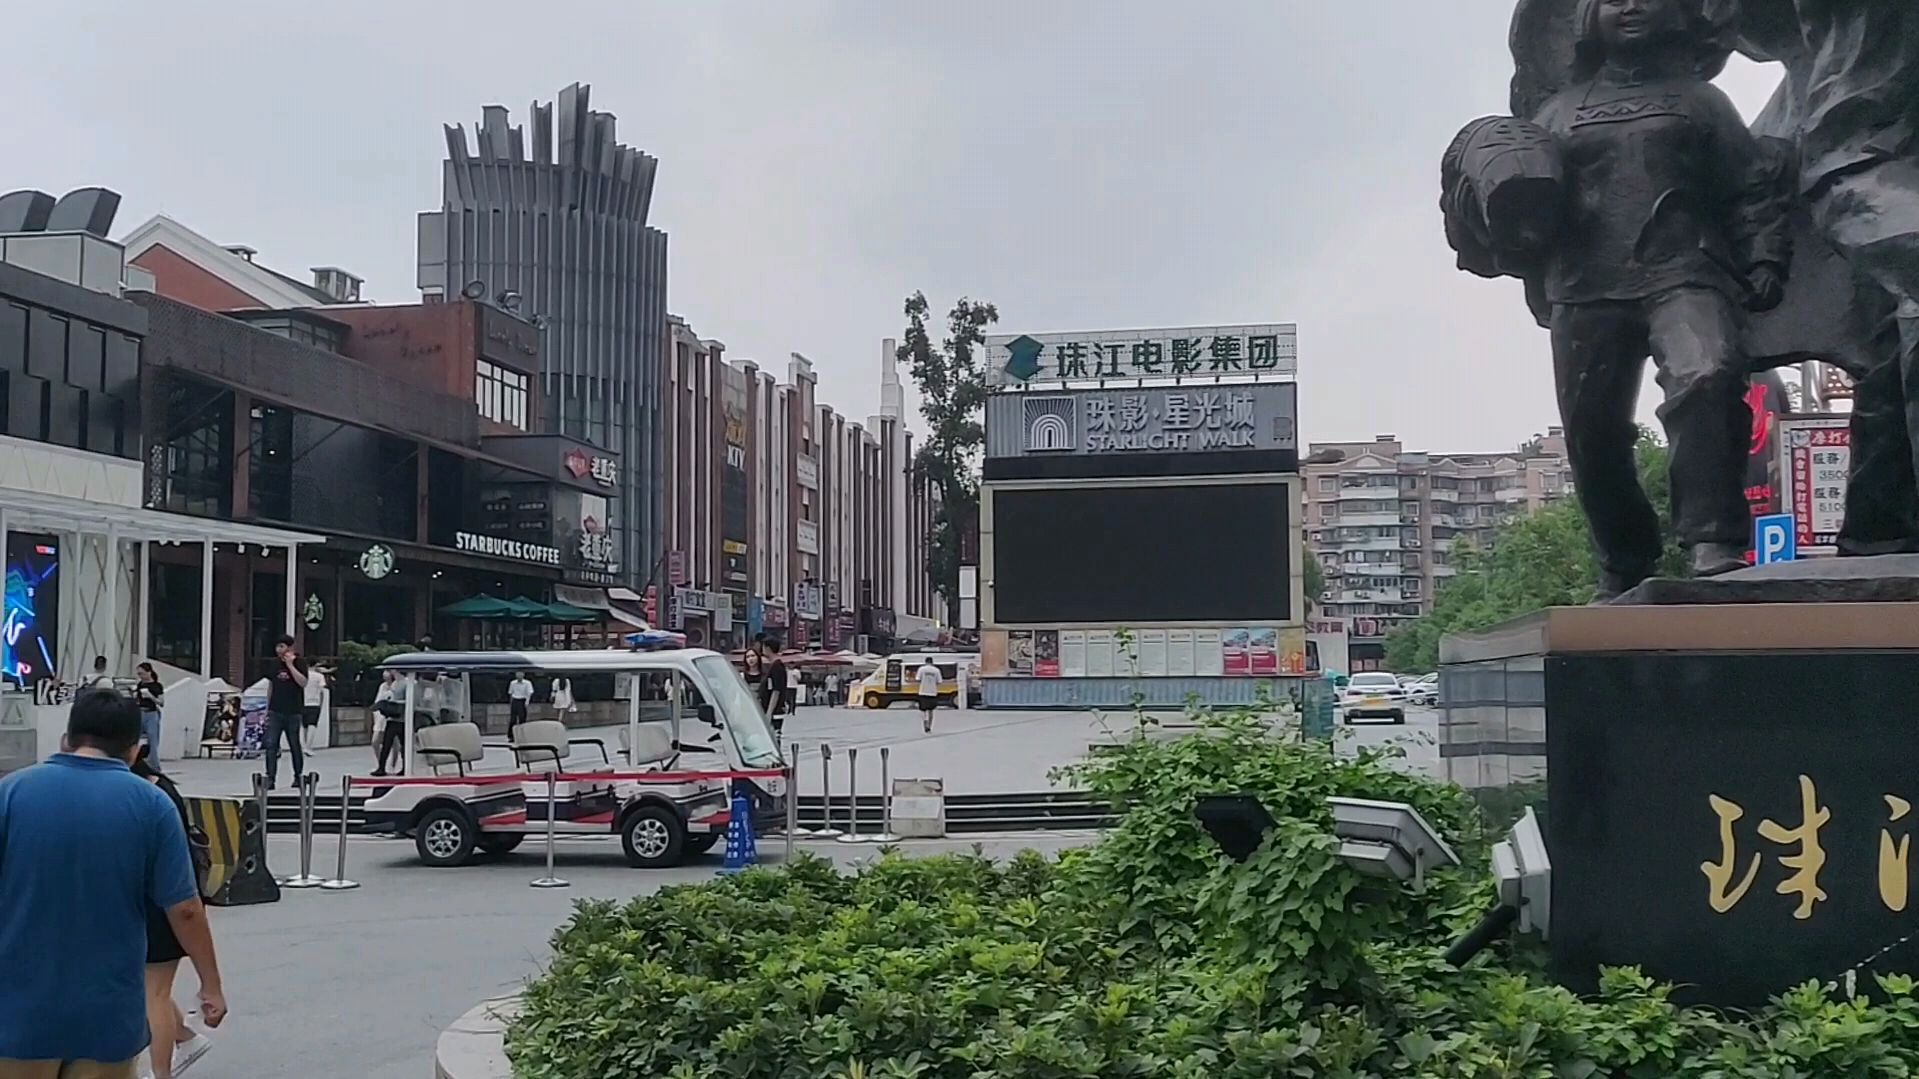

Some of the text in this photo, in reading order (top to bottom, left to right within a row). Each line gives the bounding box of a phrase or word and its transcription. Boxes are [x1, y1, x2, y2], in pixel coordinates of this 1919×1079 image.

[1056, 335, 1278, 377] 珠江电影集团
[1086, 430, 1256, 452] STARLIGHT WALK
[455, 531, 560, 564] STARBUCKS COFFEE
[1764, 525, 1785, 564] P
